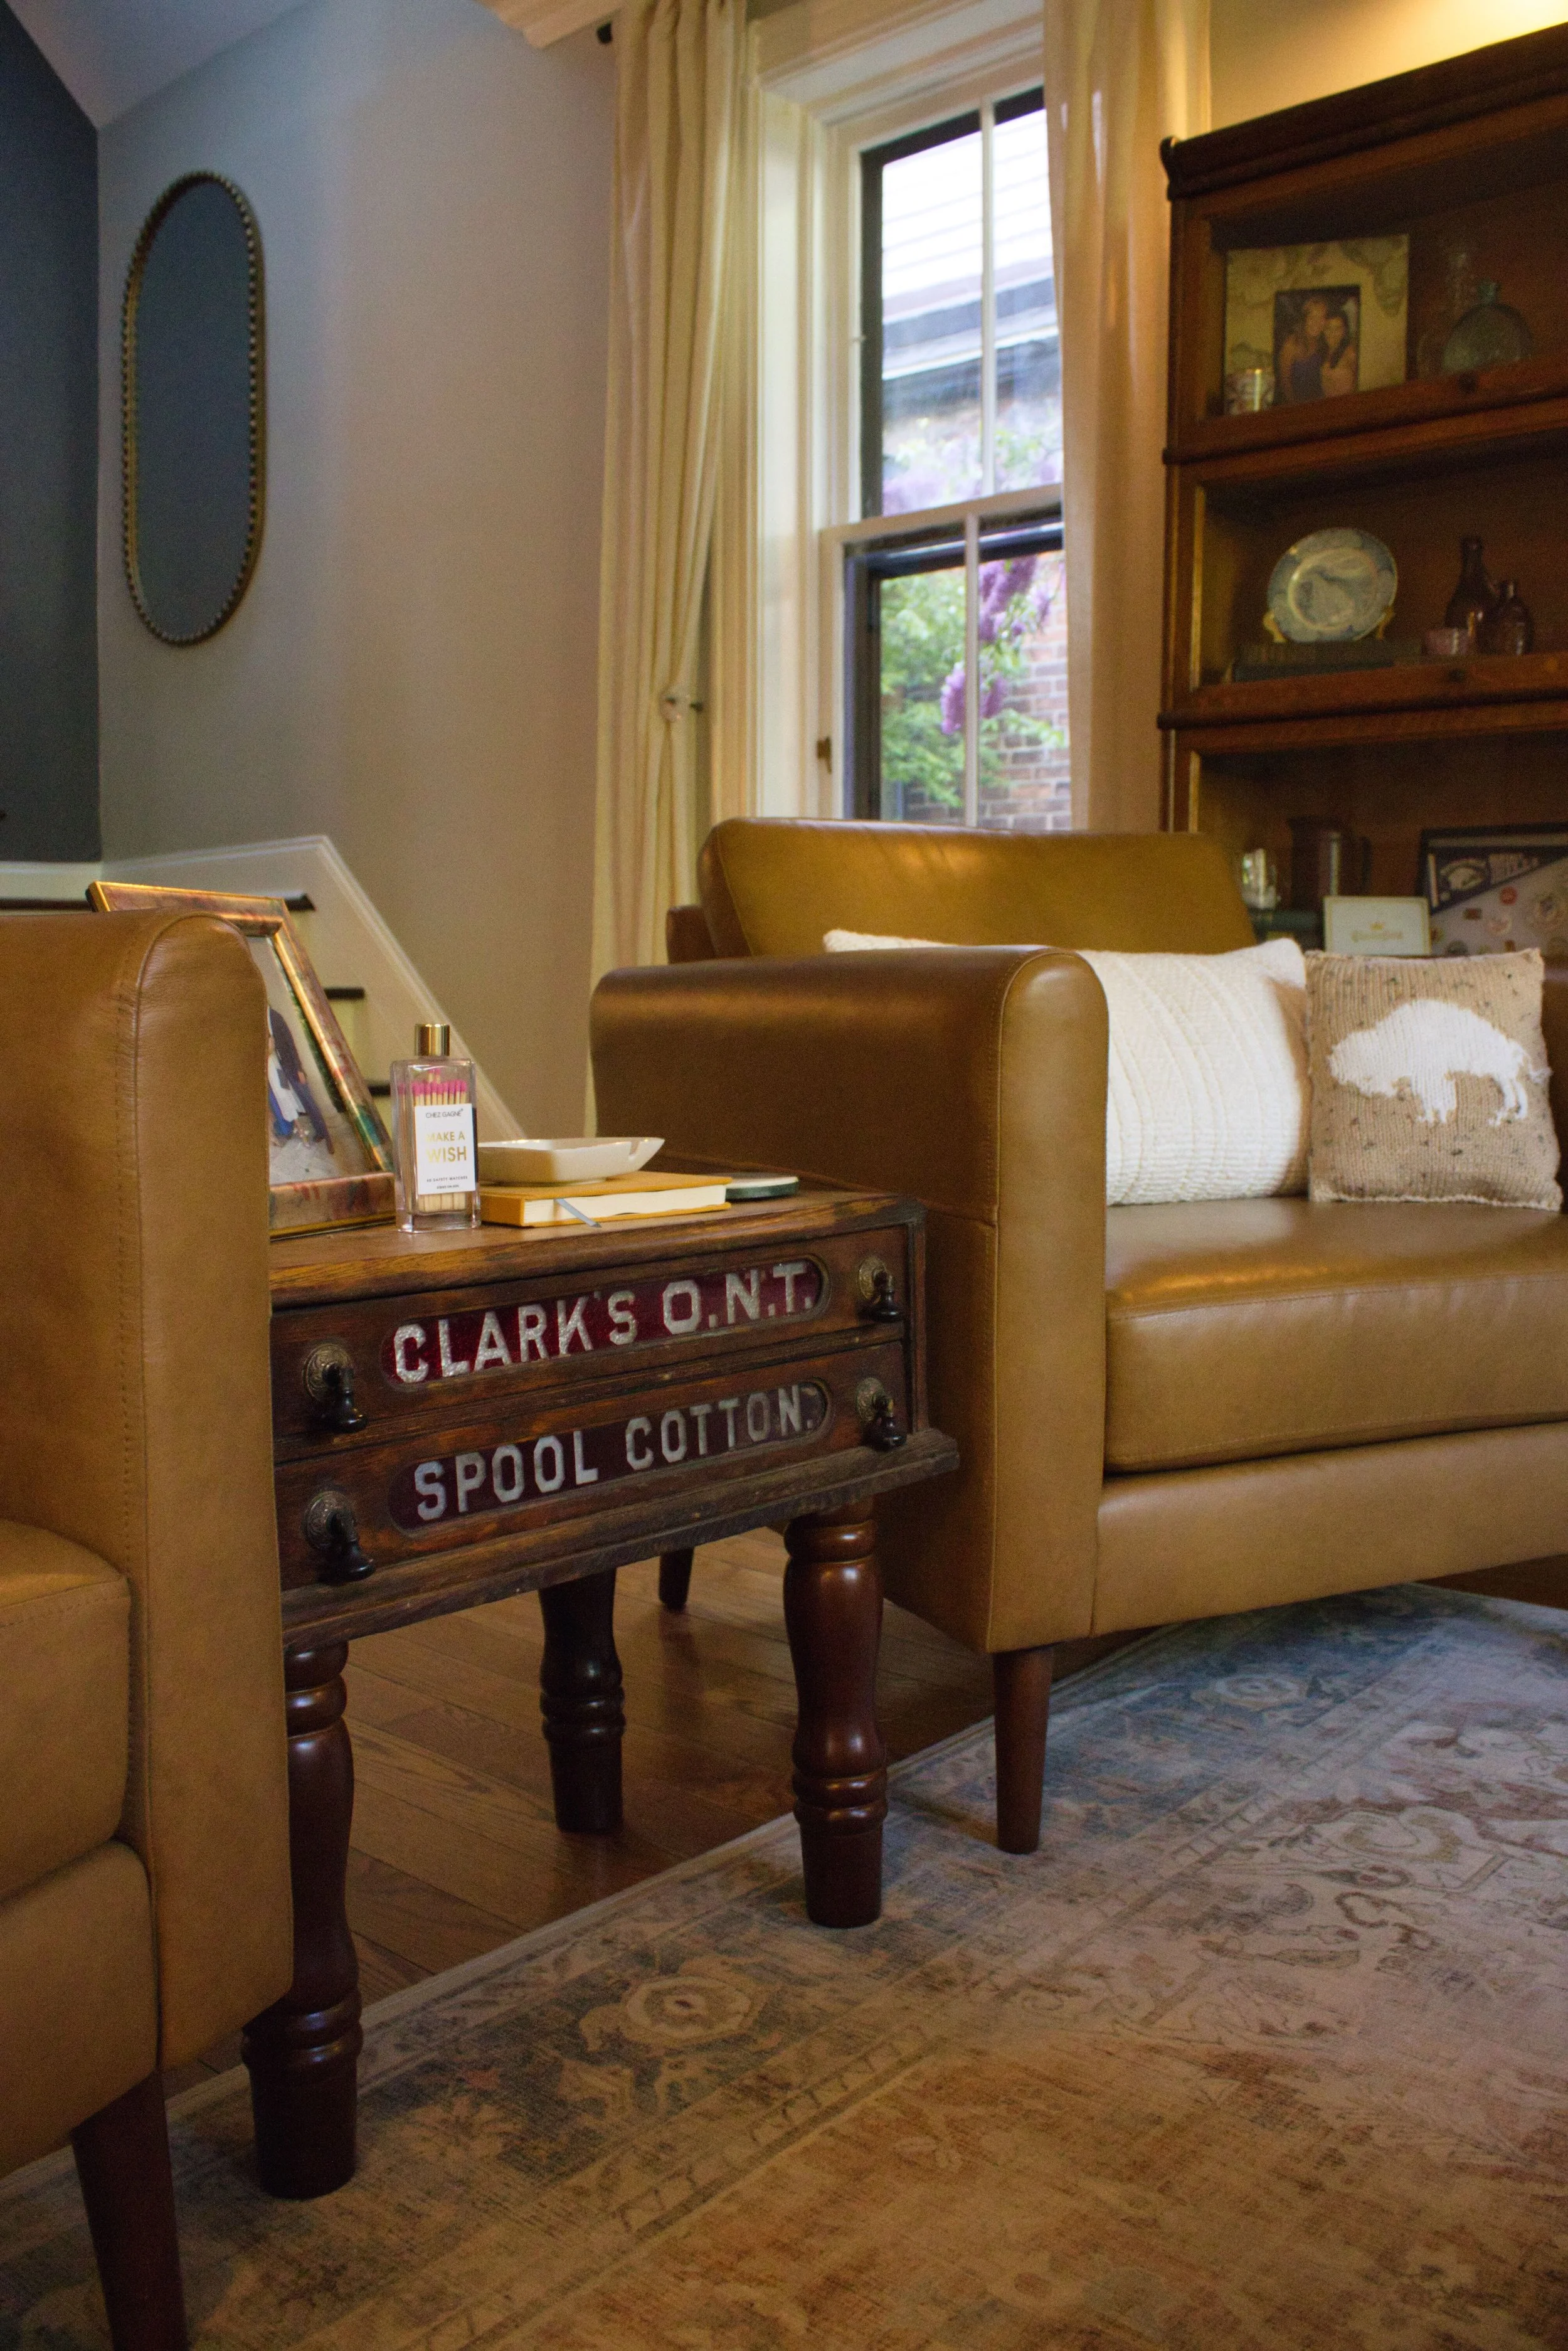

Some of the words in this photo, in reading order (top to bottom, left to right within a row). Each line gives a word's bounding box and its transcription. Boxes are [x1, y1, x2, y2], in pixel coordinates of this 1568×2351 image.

[426, 1131, 455, 1142] MAKE
[458, 1130, 465, 1140] A
[426, 1145, 467, 1164] WISH
[393, 1290, 638, 1383] CLARK'S
[662, 1261, 813, 1335] O.N.T.
[414, 1430, 599, 1521] SPOOL
